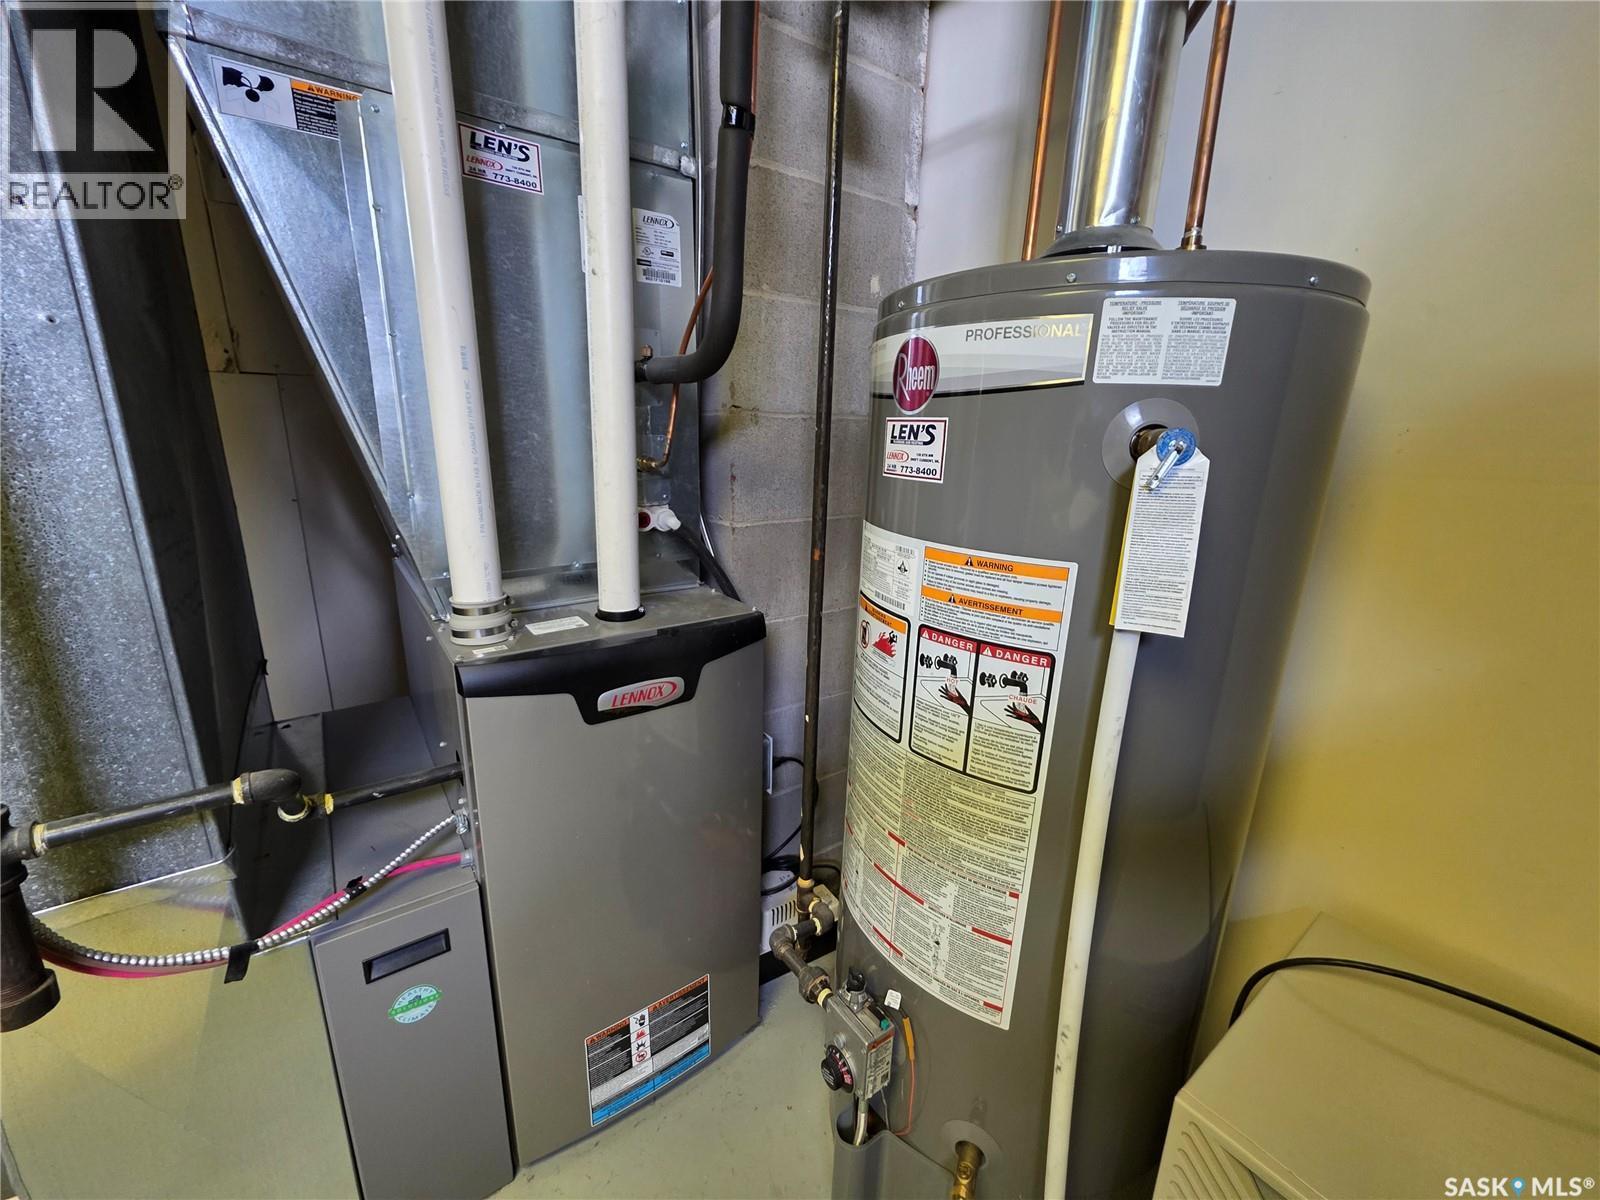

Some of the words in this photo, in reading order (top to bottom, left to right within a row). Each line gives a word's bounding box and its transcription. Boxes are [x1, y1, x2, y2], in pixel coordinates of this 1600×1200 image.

[470, 131, 530, 162] LEN'S
[466, 155, 496, 168] LENNOX
[492, 172, 537, 189] 773-8400
[642, 215, 668, 227] LENNOX
[965, 323, 1081, 342] PROFESSIONAL
[897, 352, 936, 401] Rheem
[890, 424, 937, 446] LEN'S
[887, 451, 904, 460] LENNOX
[900, 465, 937, 476] 773-8400
[976, 560, 1014, 572] WARNING
[958, 598, 1024, 616] AVERTISSEMENT
[931, 632, 974, 651] DANGER
[995, 650, 1048, 666] DANGER
[610, 683, 665, 708] LENNOX
[1008, 694, 1037, 704] CHAUDE
